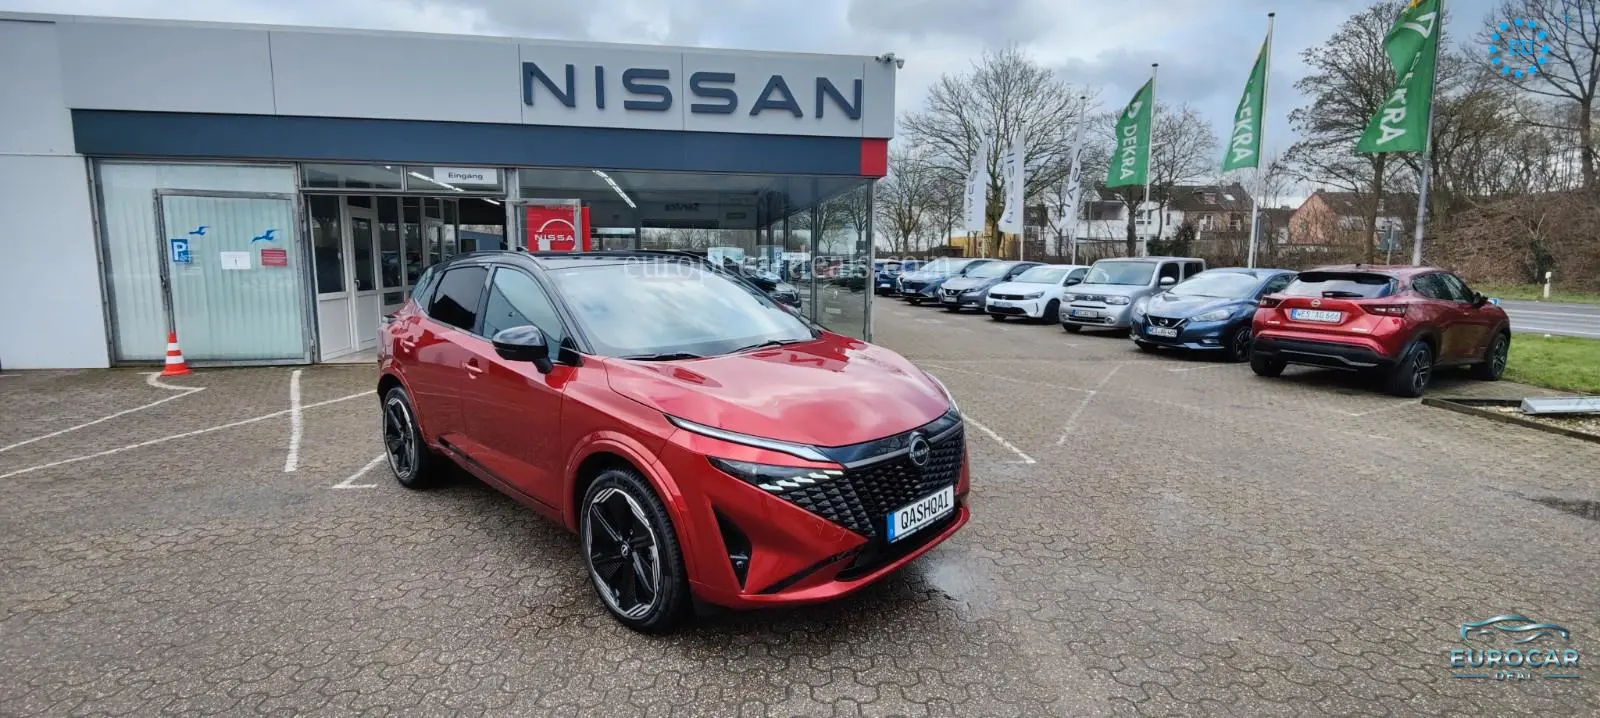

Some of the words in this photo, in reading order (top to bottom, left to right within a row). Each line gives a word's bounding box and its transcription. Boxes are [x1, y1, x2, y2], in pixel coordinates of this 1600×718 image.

[522, 61, 862, 120] NISSAN
[1120, 124, 1138, 180] DEKRA
[447, 171, 484, 181] Eingang
[534, 233, 575, 242] NISSA
[901, 491, 949, 530] QASHQAI
